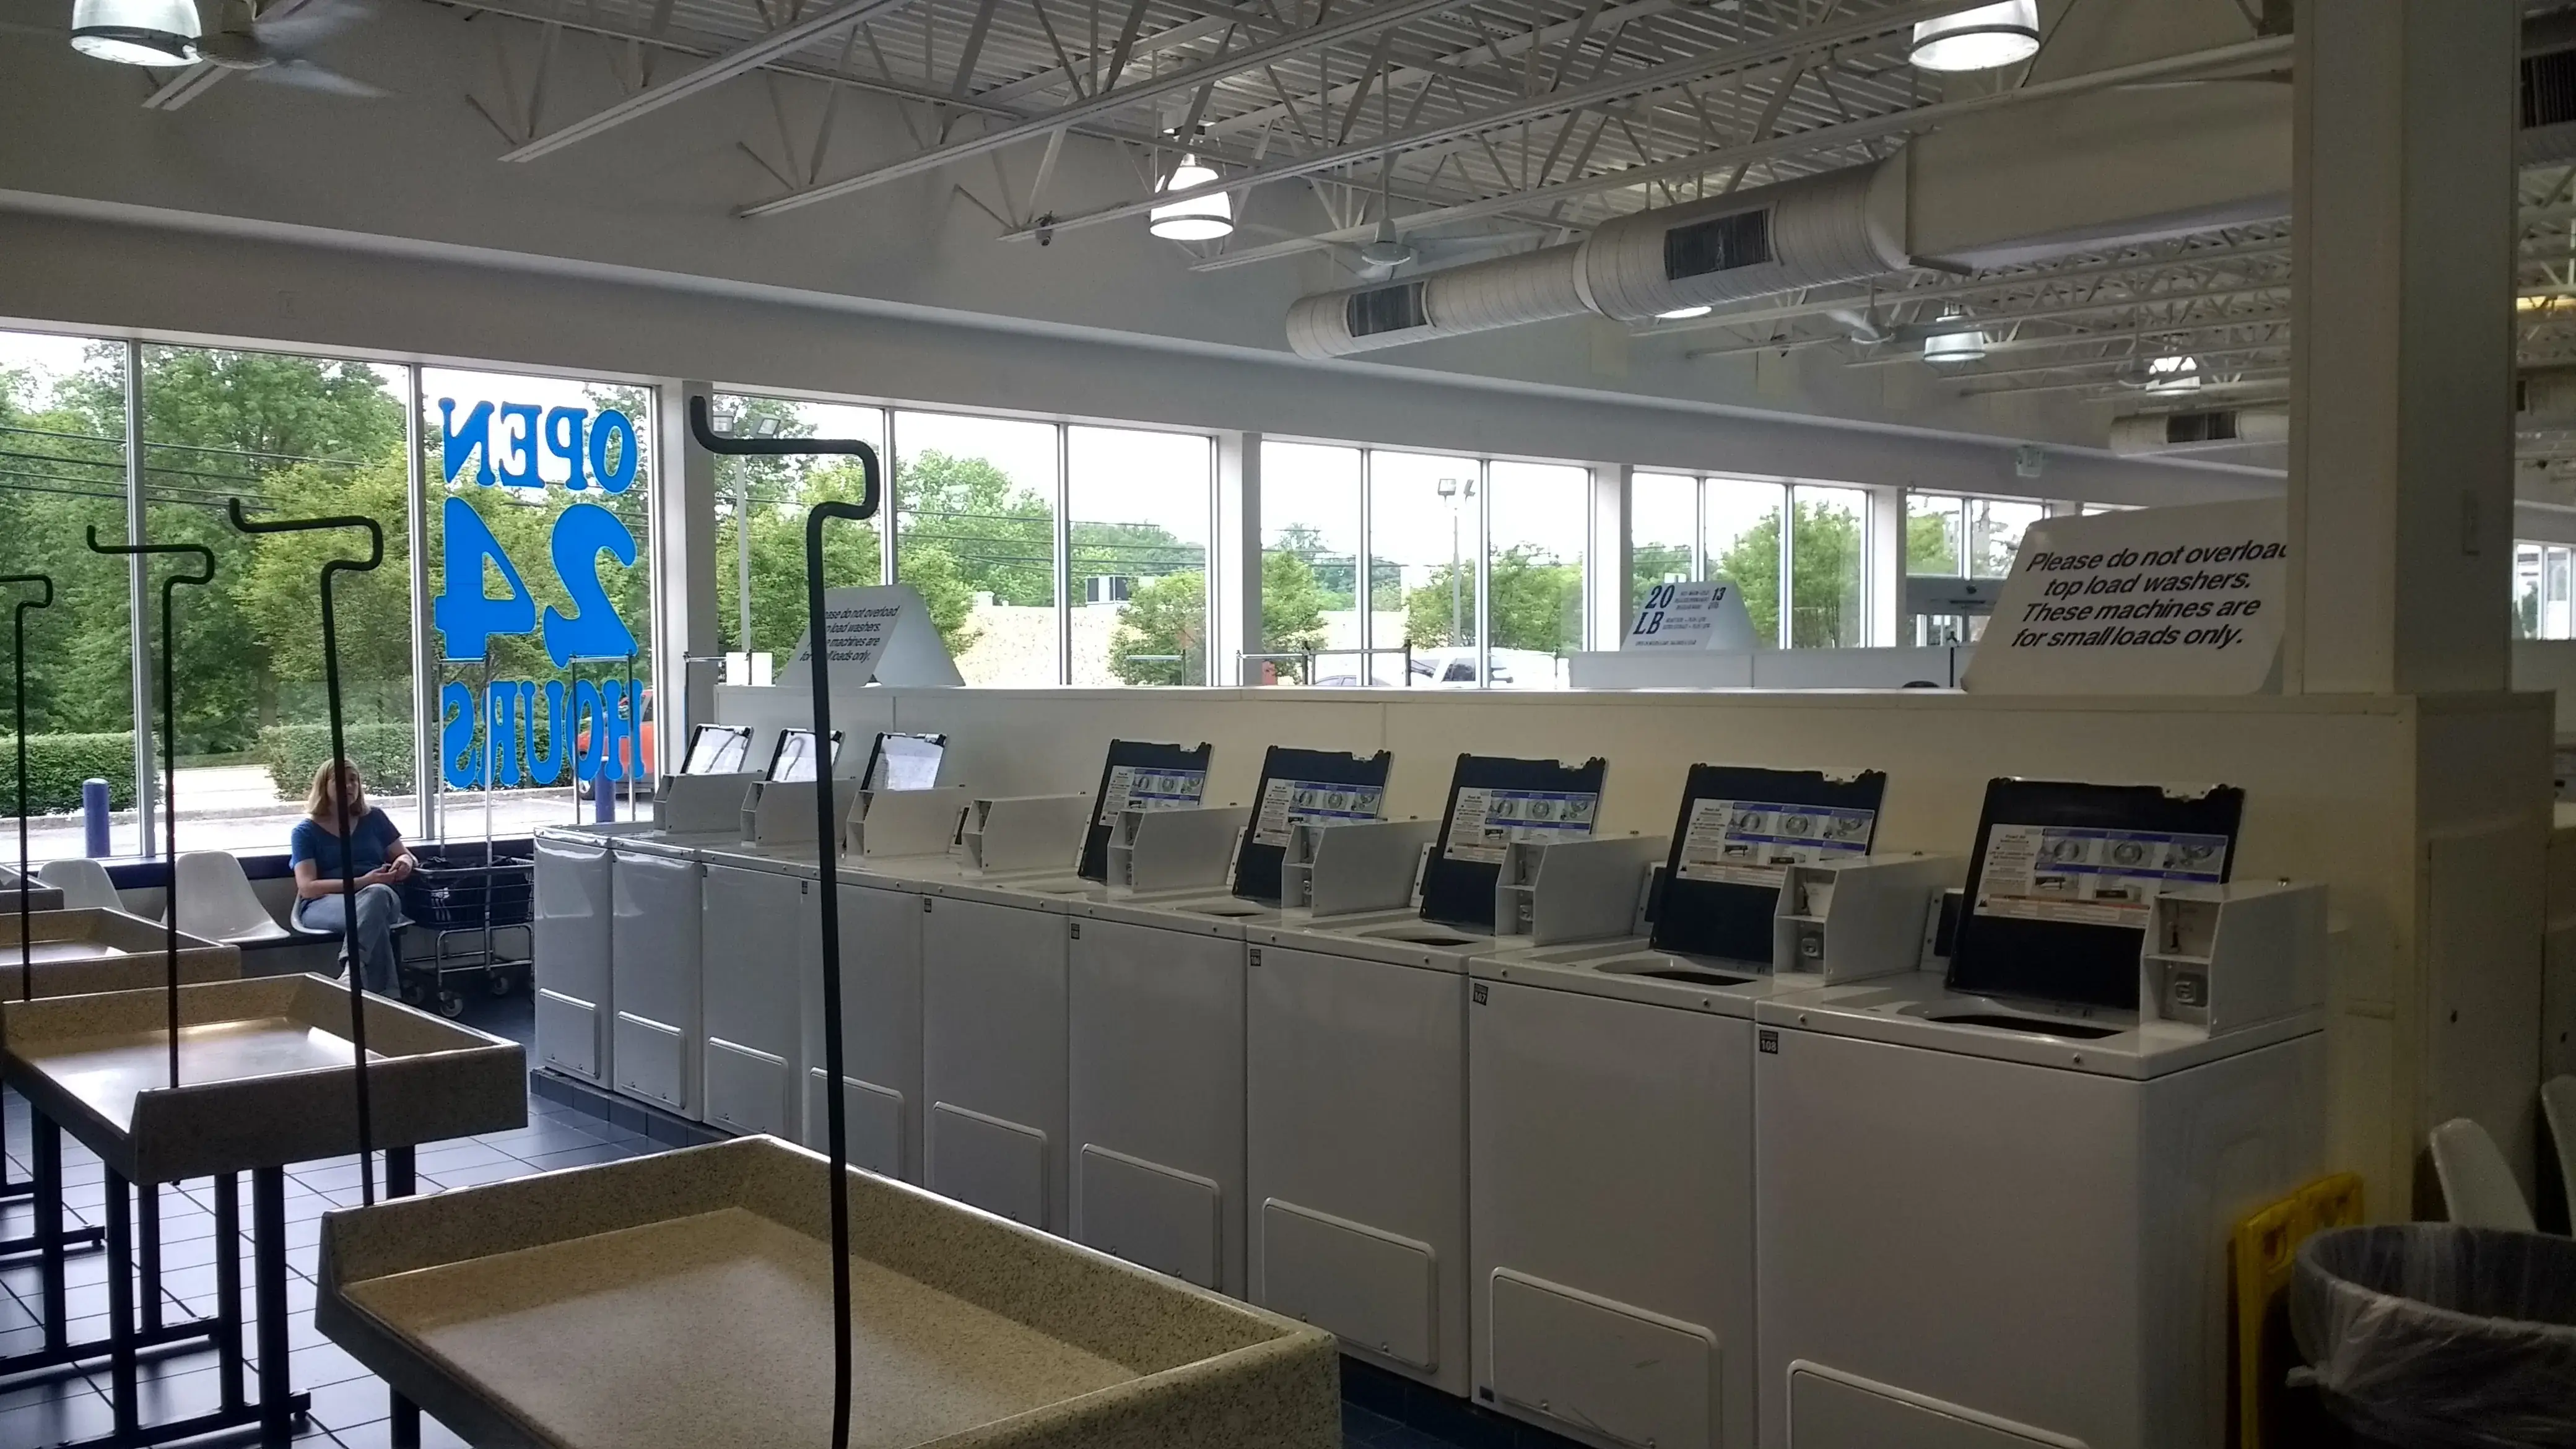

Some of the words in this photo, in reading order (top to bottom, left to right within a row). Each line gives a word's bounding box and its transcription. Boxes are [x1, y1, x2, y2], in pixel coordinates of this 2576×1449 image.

[2026, 551, 2103, 572] Please
[2107, 548, 2139, 568] do
[2140, 545, 2186, 567] not
[1645, 585, 1675, 609] 20
[1712, 587, 1726, 601] 13
[2043, 578, 2084, 601] top
[2084, 573, 2143, 595] load
[2143, 570, 2251, 593] washers.
[825, 610, 841, 619] ease
[840, 607, 852, 619] do
[851, 607, 866, 618] not
[864, 605, 901, 617] overload
[2021, 603, 2095, 622] These
[2094, 598, 2213, 620] machines
[2216, 599, 2262, 617] are
[830, 622, 849, 633] load
[1633, 612, 1664, 635] LB
[830, 636, 867, 647] machines
[866, 637, 881, 646] are
[2011, 627, 2047, 648] for
[2047, 626, 2117, 648] small
[2110, 624, 2180, 646] loads
[2183, 624, 2244, 650] only.
[1761, 1040, 1777, 1051] 108
